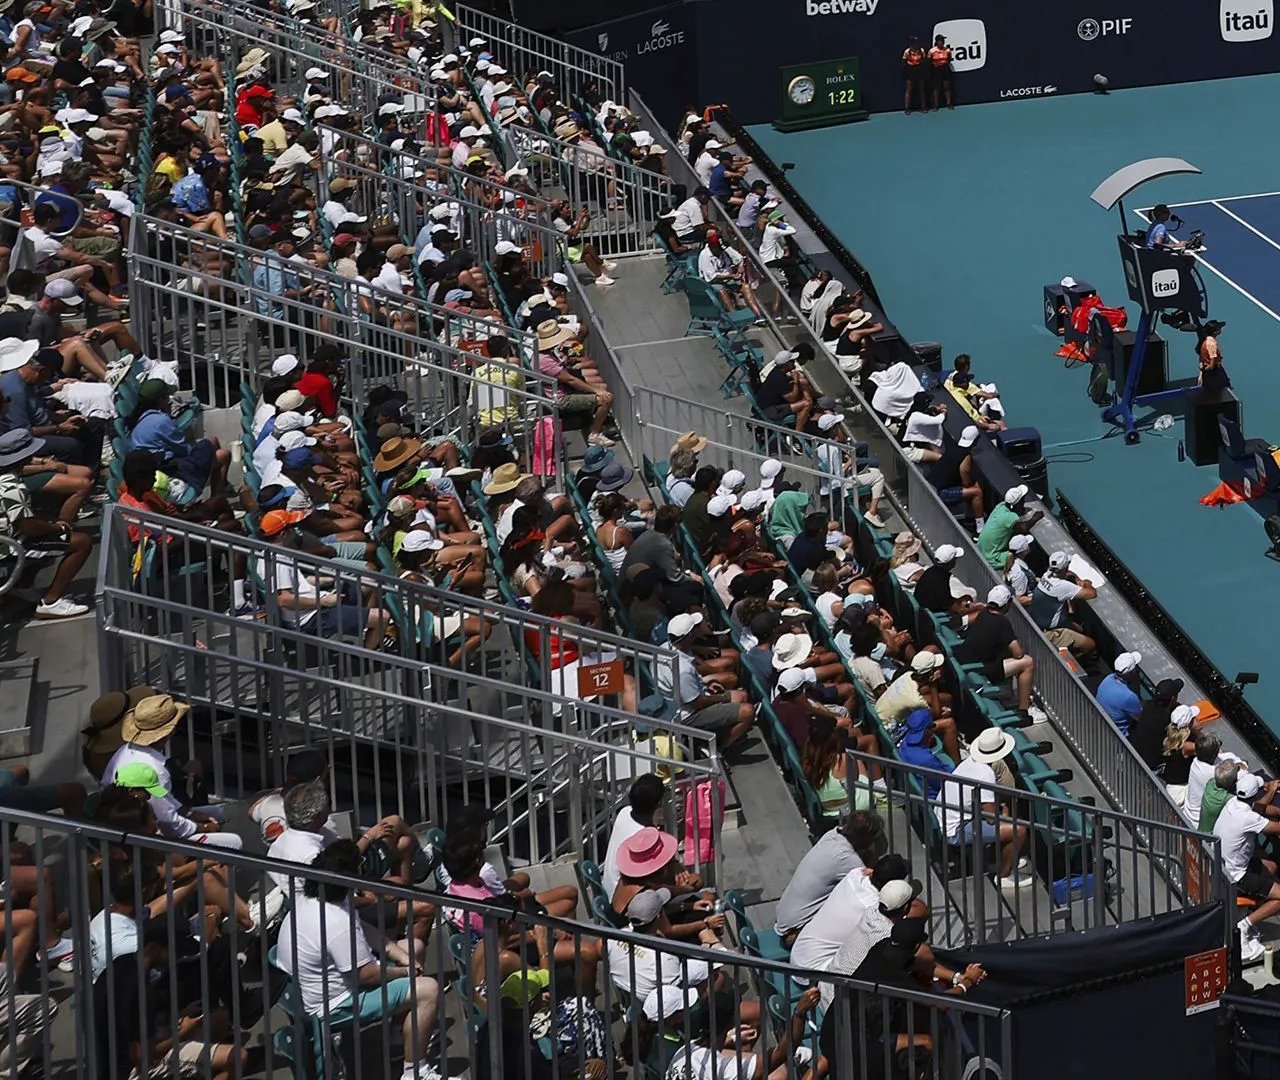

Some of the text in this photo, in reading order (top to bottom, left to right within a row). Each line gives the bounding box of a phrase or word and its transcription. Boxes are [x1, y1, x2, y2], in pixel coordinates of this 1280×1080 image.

[1101, 17, 1133, 36] PIF
[1225, 9, 1268, 32] itaú
[637, 31, 684, 55] LACOSTE
[944, 40, 981, 62] taú
[826, 73, 856, 85] ROLEX
[827, 88, 855, 105] 1:22
[1000, 86, 1042, 98] LACOSTE
[1153, 278, 1177, 293] itaú
[590, 666, 612, 674] SECTION
[592, 673, 609, 687] 12
[1190, 973, 1198, 981] A
[1215, 966, 1221, 974] C
[1215, 977, 1221, 986] S
[1191, 990, 1211, 1002] U W
